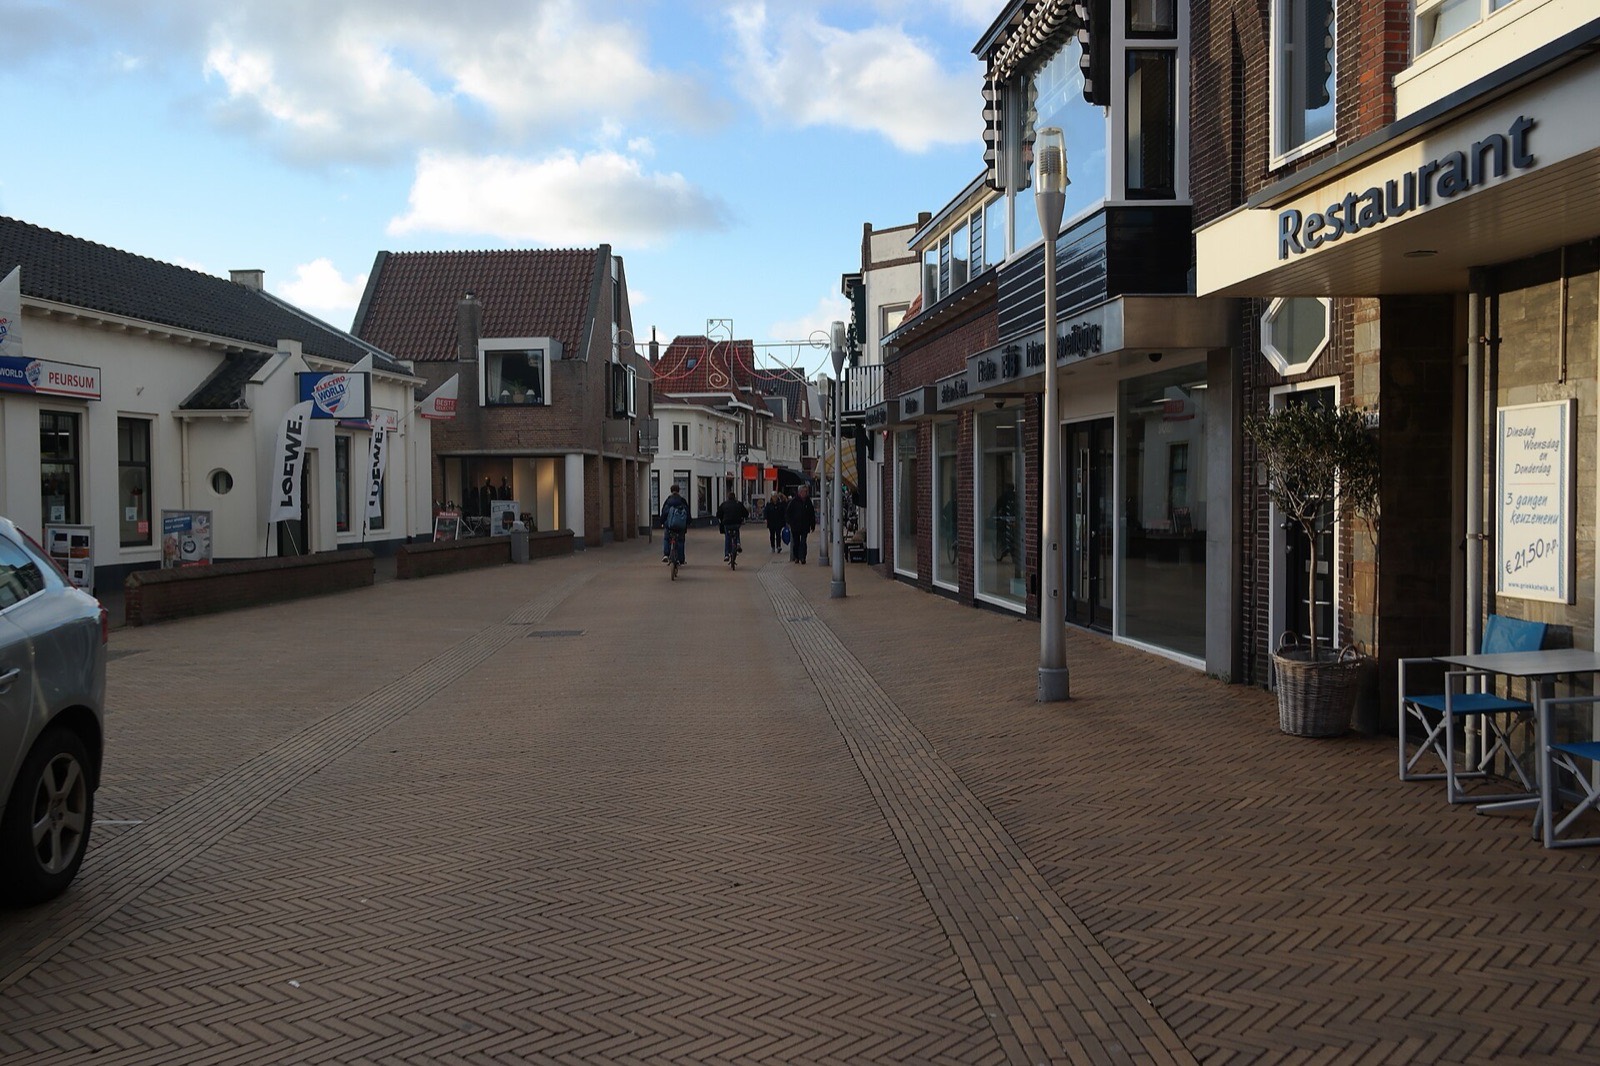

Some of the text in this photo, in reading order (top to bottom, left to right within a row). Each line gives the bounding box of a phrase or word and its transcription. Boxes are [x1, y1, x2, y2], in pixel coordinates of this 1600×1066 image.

[1278, 115, 1534, 260] Restaurant
[49, 372, 94, 389] PEURSUM
[315, 375, 345, 391] ELECTRO
[317, 384, 345, 401] WORLD
[1506, 426, 1536, 438] Dinsdag
[1523, 438, 1560, 452] Woensdag
[1539, 452, 1548, 461] en
[1514, 462, 1551, 476] Donderdag
[1505, 492, 1548, 509] 3 gangen
[1510, 510, 1559, 525] keuzemenu
[1505, 560, 1513, 575] €
[1514, 538, 1544, 572] 21,50
